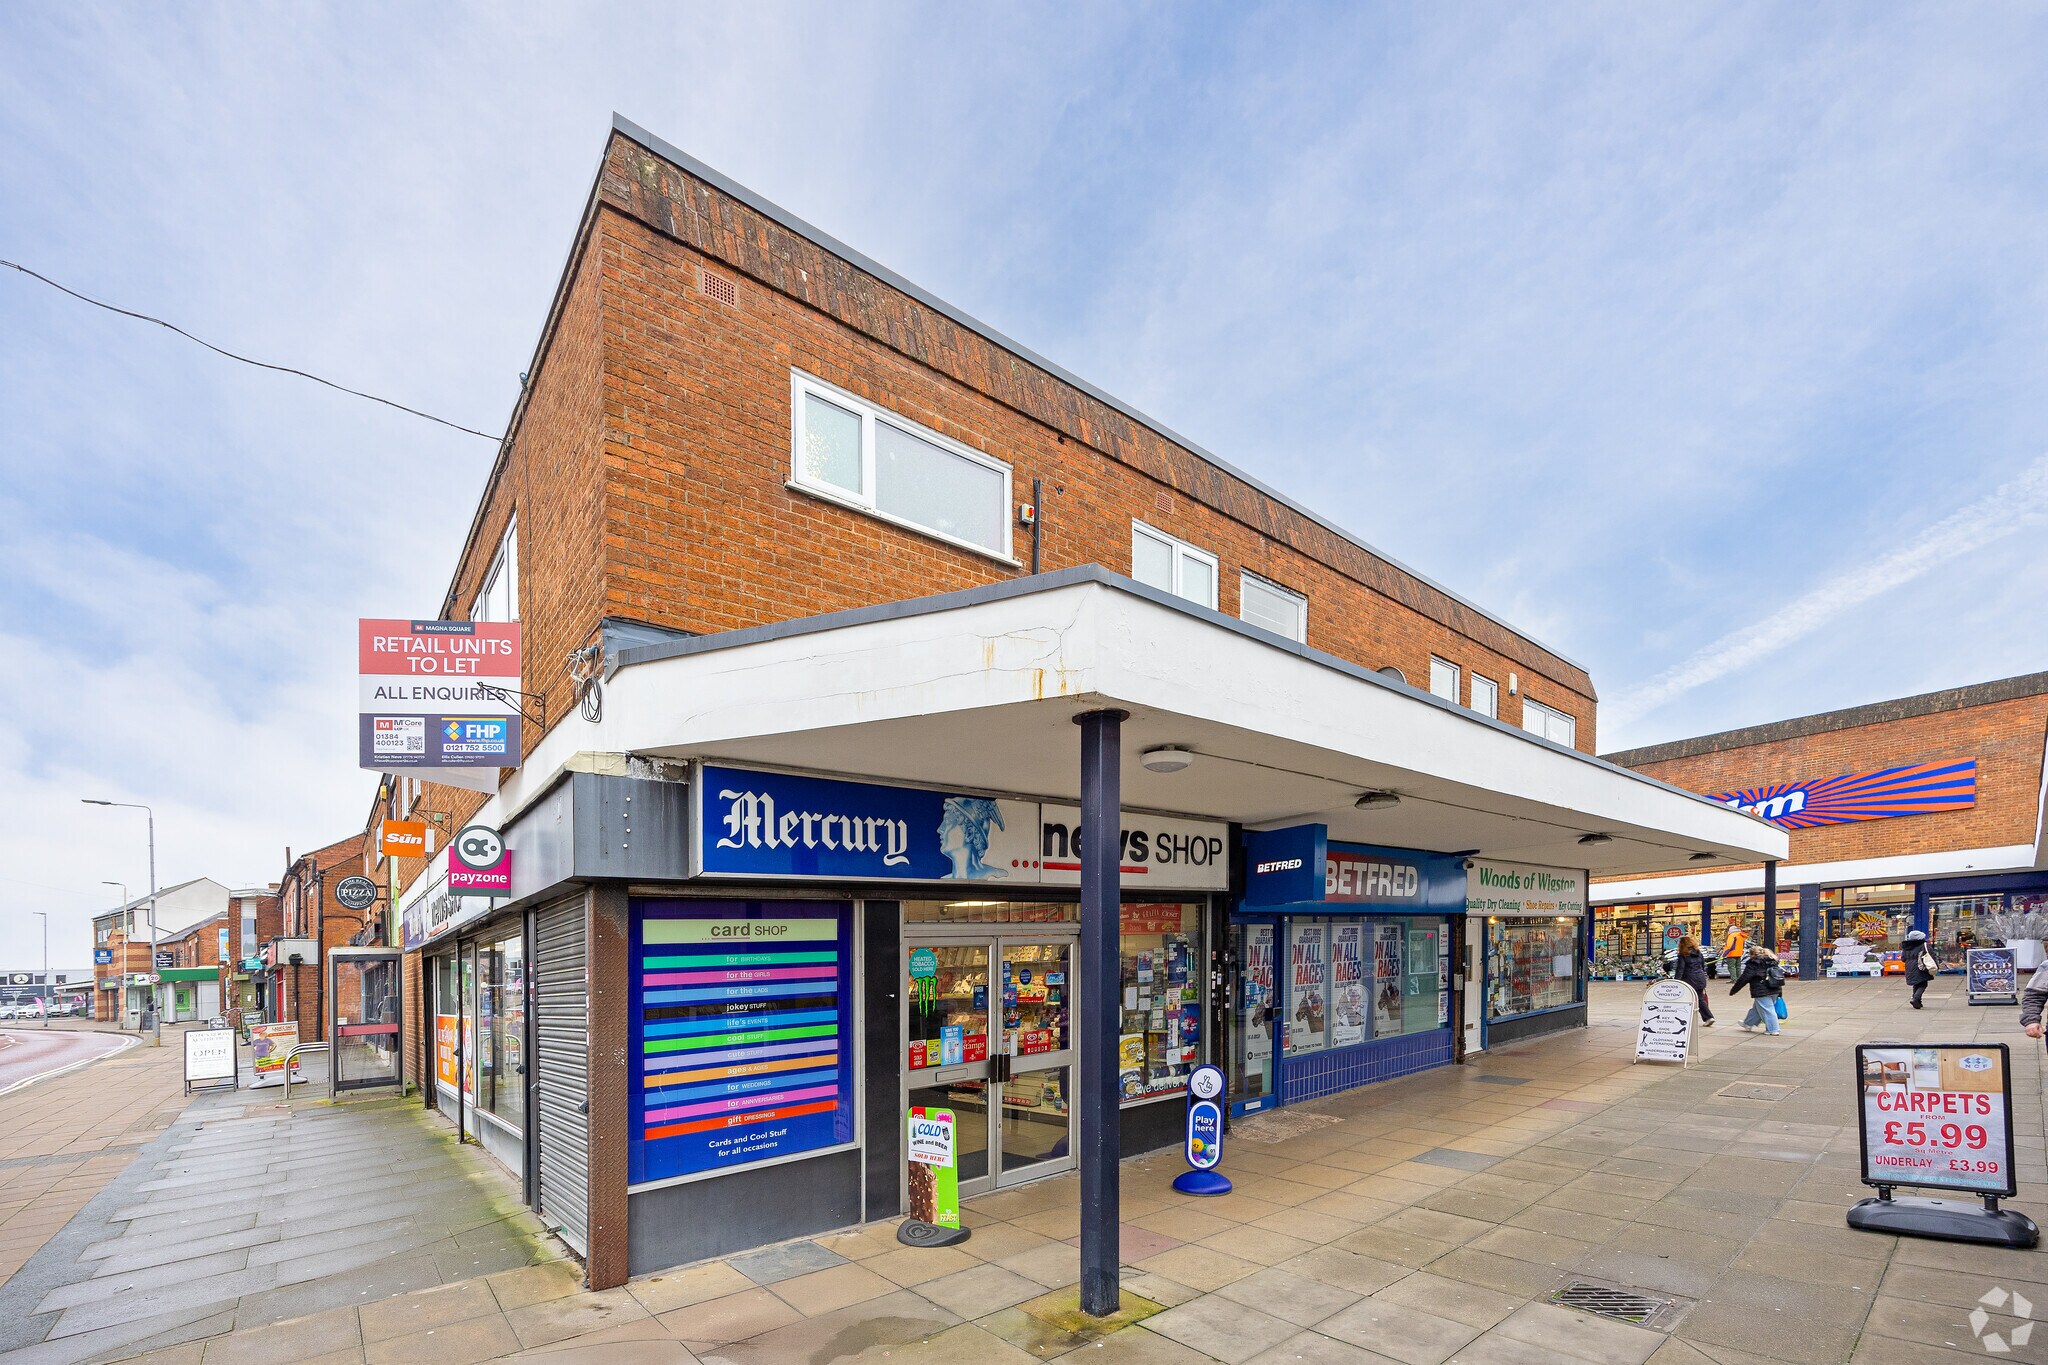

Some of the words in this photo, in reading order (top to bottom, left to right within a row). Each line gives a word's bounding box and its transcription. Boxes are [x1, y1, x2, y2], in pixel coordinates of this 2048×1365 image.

[373, 636, 445, 653] RETAIL
[450, 639, 513, 655] UNITS
[407, 656, 437, 673] TO
[444, 657, 480, 673] LET
[374, 686, 408, 700] ALL
[413, 686, 506, 701] ENQUIRIES
[466, 724, 501, 739] FHP
[716, 789, 910, 865] Mercury
[1155, 832, 1222, 866] SHOP
[1257, 858, 1302, 873] BETFRED
[451, 872, 508, 884] payzone
[1325, 859, 1418, 897] BETFRED
[1480, 867, 1520, 889] Woods
[1523, 873, 1536, 890] of
[1538, 873, 1575, 892] Wigston
[1466, 897, 1486, 911] Quality
[1487, 898, 1497, 912] Dry
[1498, 899, 1521, 912] Cleaning
[1526, 900, 1537, 910] Shoe
[1538, 900, 1555, 912] Repairs
[1558, 901, 1566, 912] Key
[1567, 902, 1582, 913] Cutting
[711, 923, 750, 937] card
[755, 925, 787, 936] SHOP
[1305, 944, 1321, 964] ALL
[1343, 943, 1358, 961] ALL
[1384, 941, 1397, 959] ALL
[1295, 963, 1324, 985] RACES
[1335, 961, 1361, 981] RACES
[1377, 959, 1400, 978] RACES
[726, 1003, 748, 1012] jokey
[727, 1034, 744, 1042] cool
[193, 1048, 226, 1057] OPEN
[727, 1050, 745, 1058] cute
[963, 1042, 985, 1051] stamps
[727, 1067, 747, 1075] ages
[727, 1083, 739, 1091] for
[741, 1080, 771, 1088] WEDDINGS
[741, 1094, 784, 1105] ANNIVERSARIES
[1877, 1091, 1991, 1115] CARPETS
[727, 1115, 741, 1125] gift
[744, 1111, 775, 1121] DRESSINGS
[1195, 1116, 1215, 1125] Play
[918, 1123, 941, 1137] COLD
[1884, 1121, 1988, 1150] £5.99
[709, 1138, 731, 1148] Cards
[734, 1135, 748, 1143] and
[750, 1131, 767, 1141] Cool
[769, 1128, 787, 1137] Stuff
[718, 1149, 730, 1157] for
[732, 1147, 740, 1155] all
[743, 1142, 778, 1153] occasions
[934, 1141, 948, 1151] BEER
[1875, 1155, 1933, 1168] UNDERLAY
[1949, 1159, 1998, 1173] £3.99
